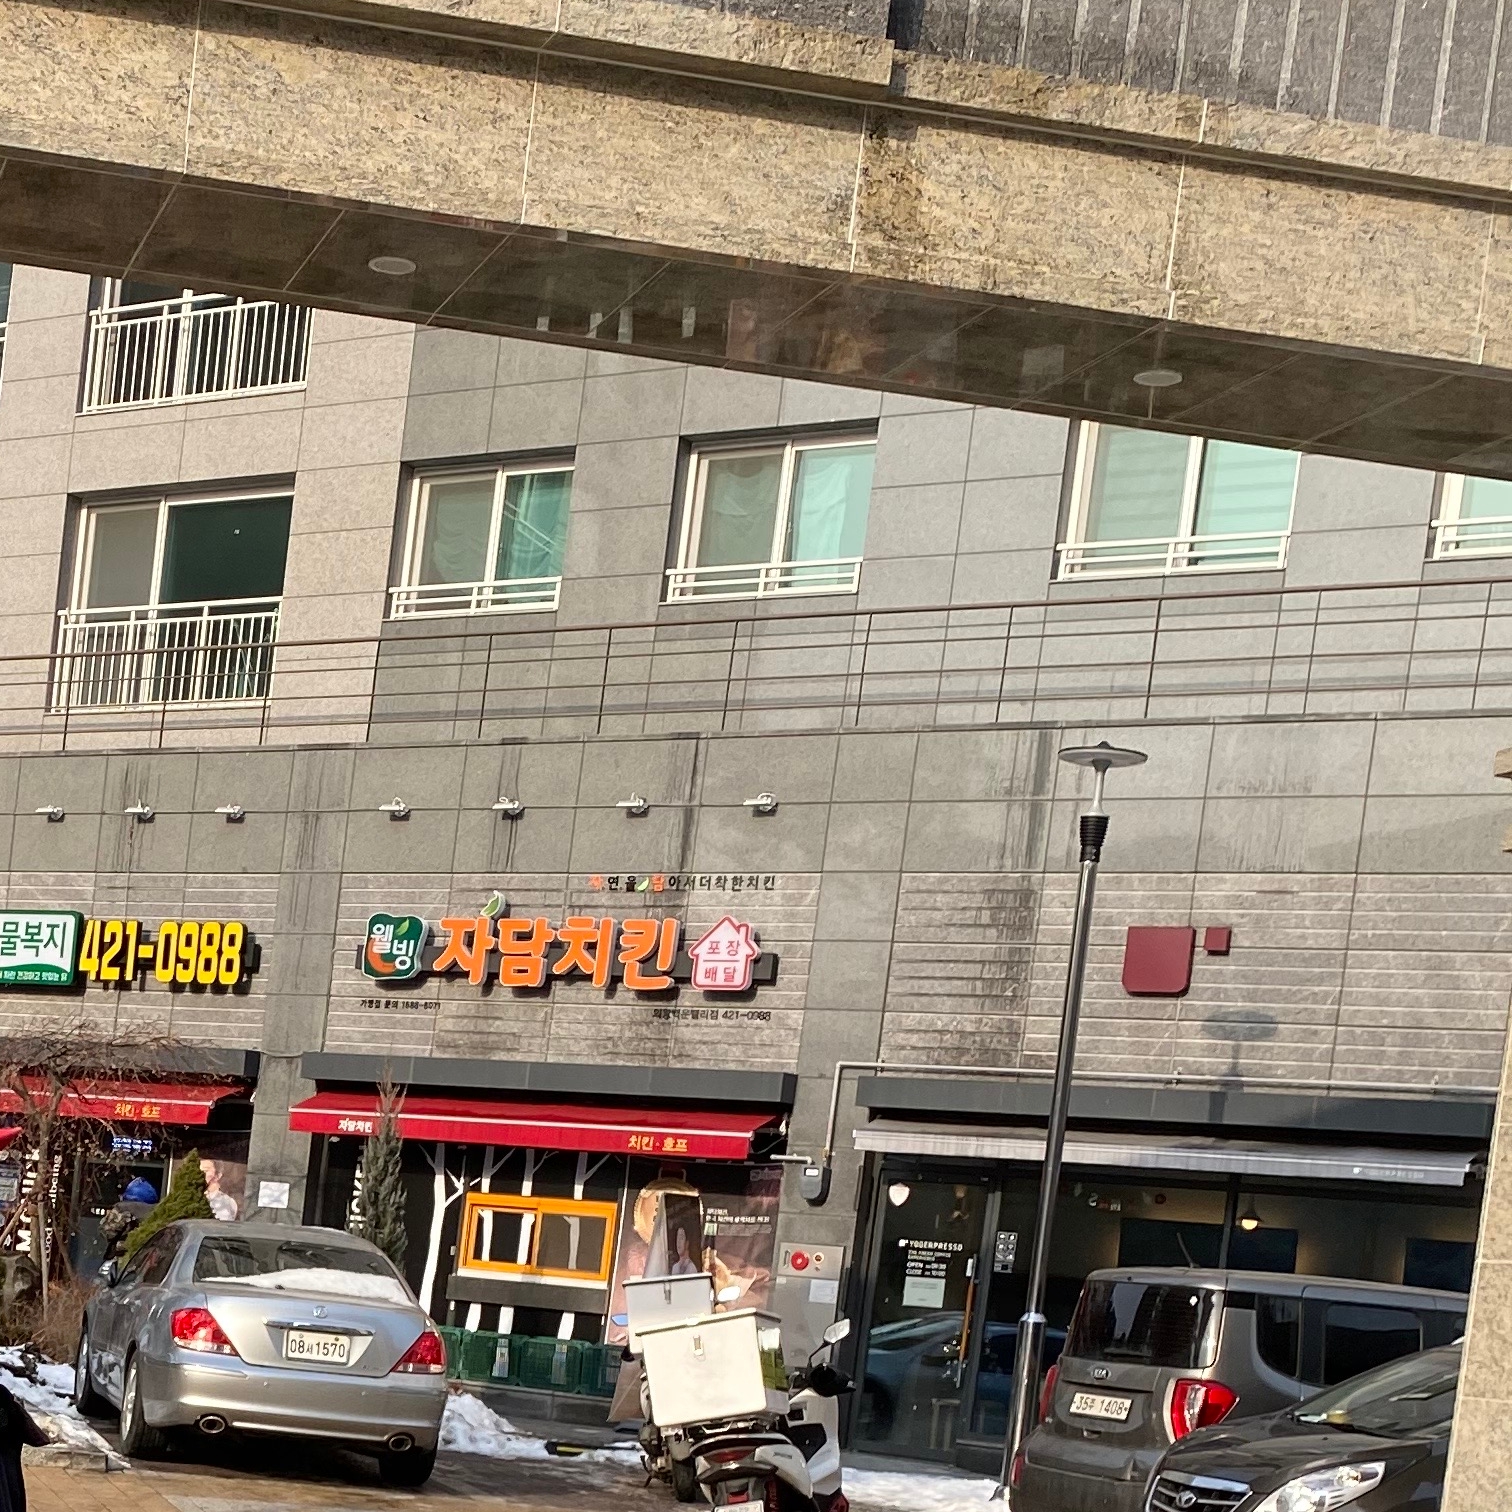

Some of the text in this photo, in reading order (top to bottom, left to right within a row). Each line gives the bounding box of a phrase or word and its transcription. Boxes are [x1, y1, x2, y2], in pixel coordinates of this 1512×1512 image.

[79, 919, 244, 985] 421-0988
[371, 924, 412, 970] 웰빙
[433, 916, 681, 990] 자담치킨
[706, 940, 740, 957] 포장
[704, 966, 736, 982] 배달
[1099, 1398, 1125, 1415] 1408
